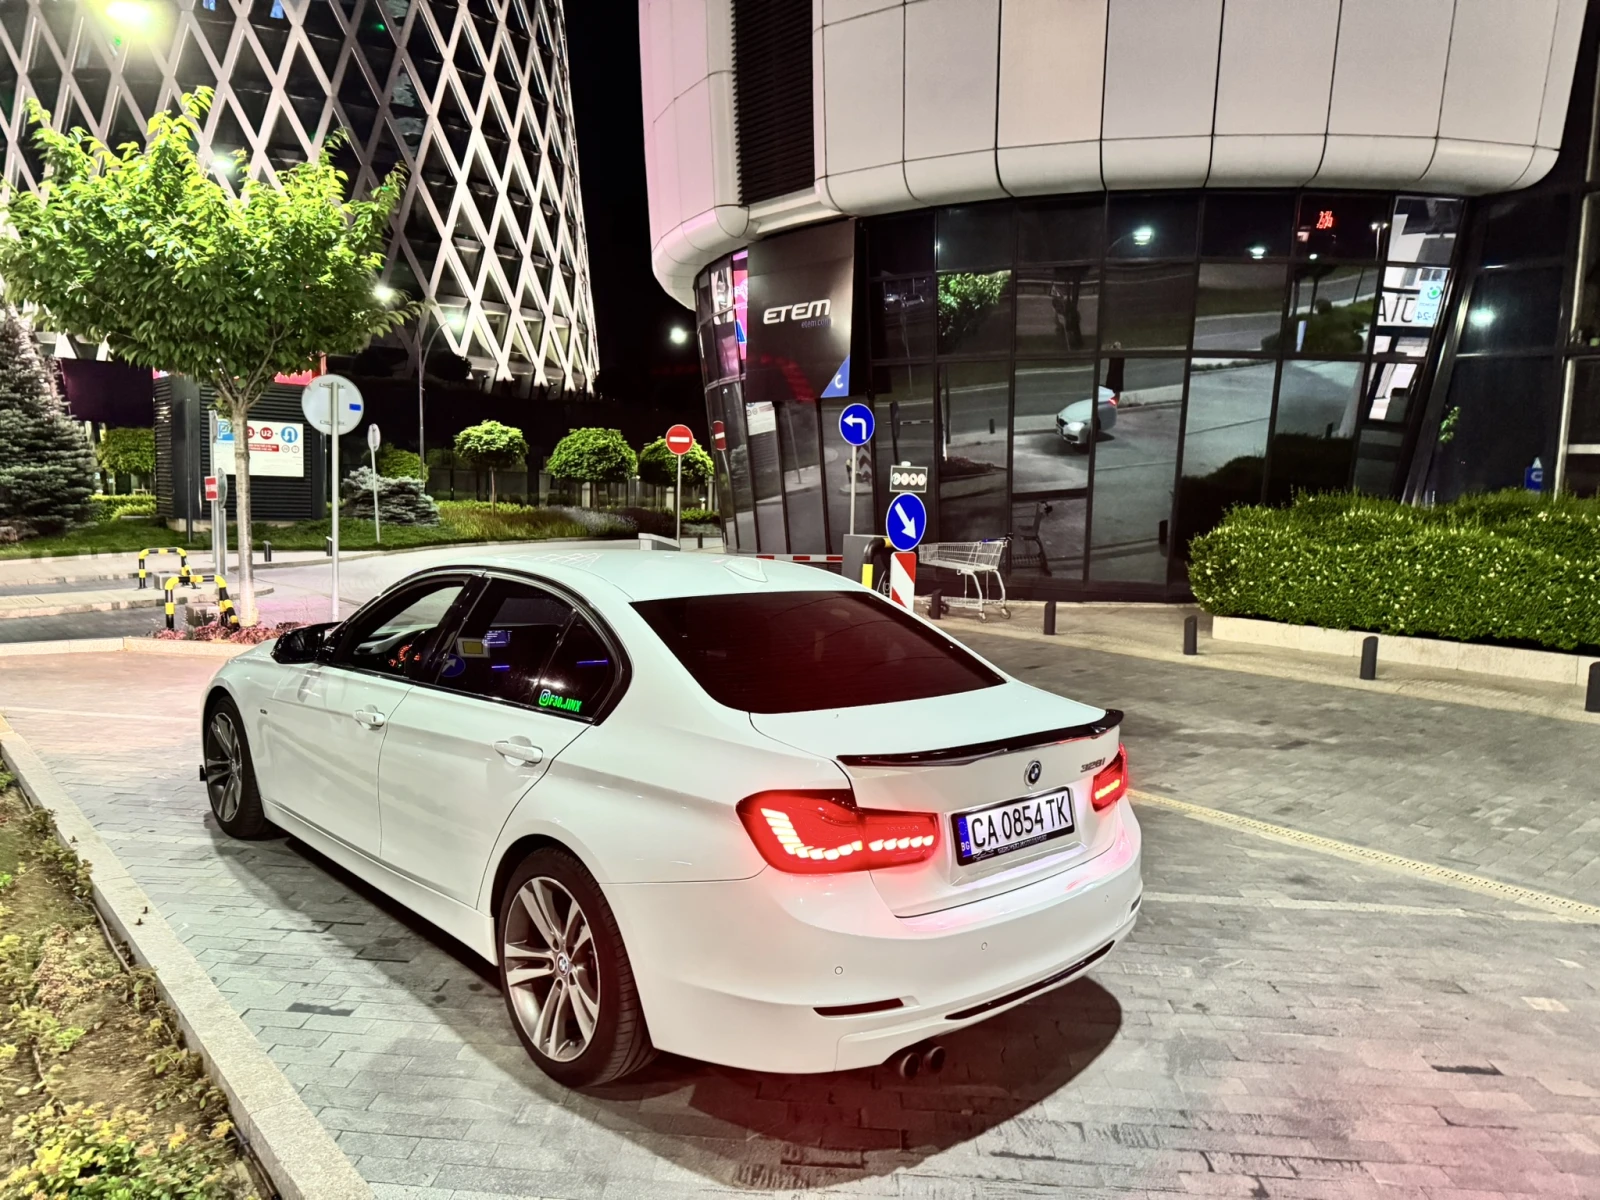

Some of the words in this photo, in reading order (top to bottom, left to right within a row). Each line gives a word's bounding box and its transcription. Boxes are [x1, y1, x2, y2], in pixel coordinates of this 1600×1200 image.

[763, 299, 831, 325] ETEM
[834, 374, 843, 388] C
[260, 429, 272, 437] U2
[971, 814, 999, 848] CA
[1001, 802, 1044, 841] 0854
[1045, 795, 1069, 829] TK
[960, 841, 971, 852] BG
